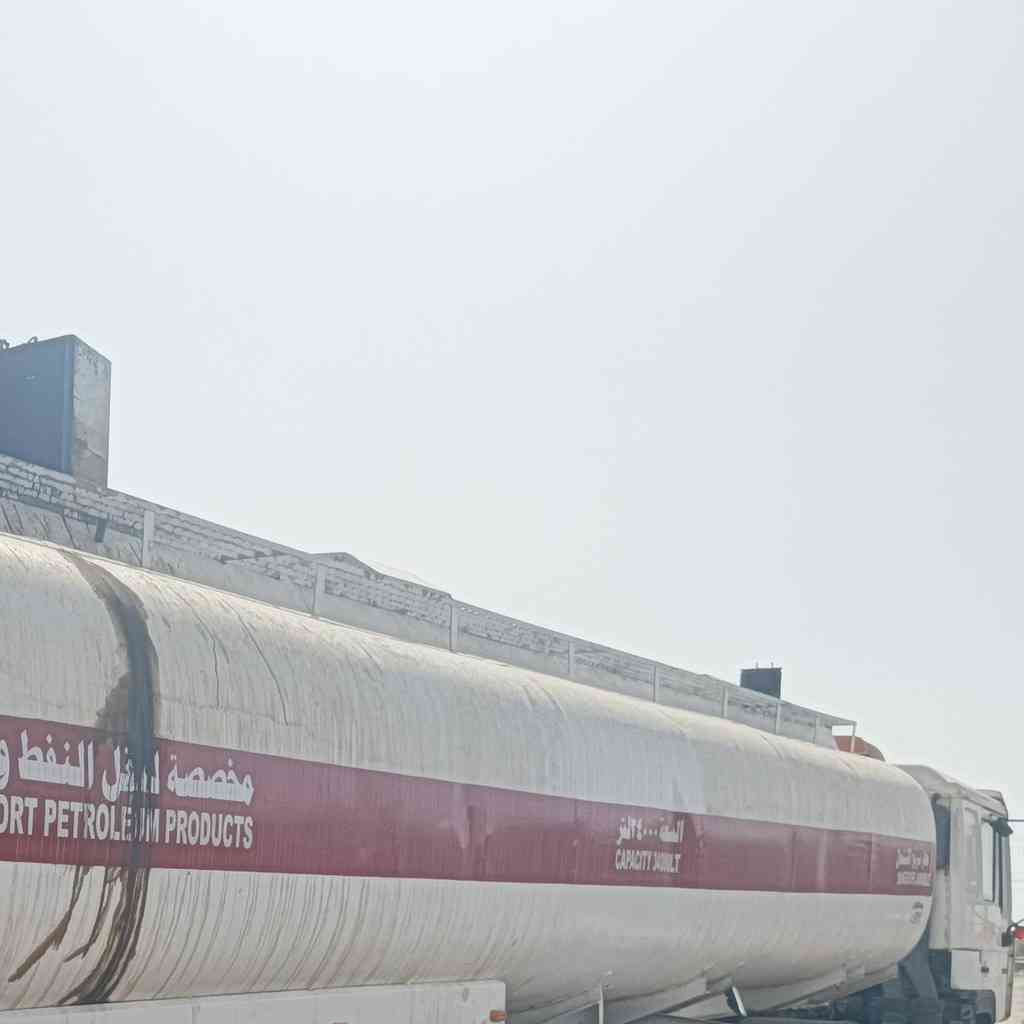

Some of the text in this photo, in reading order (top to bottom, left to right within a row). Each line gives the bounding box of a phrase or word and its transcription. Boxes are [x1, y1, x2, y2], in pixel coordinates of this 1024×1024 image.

[18, 729, 94, 789] النفط
[167, 754, 255, 806] مخصصة
[165, 809, 254, 849] PRODUCTS
